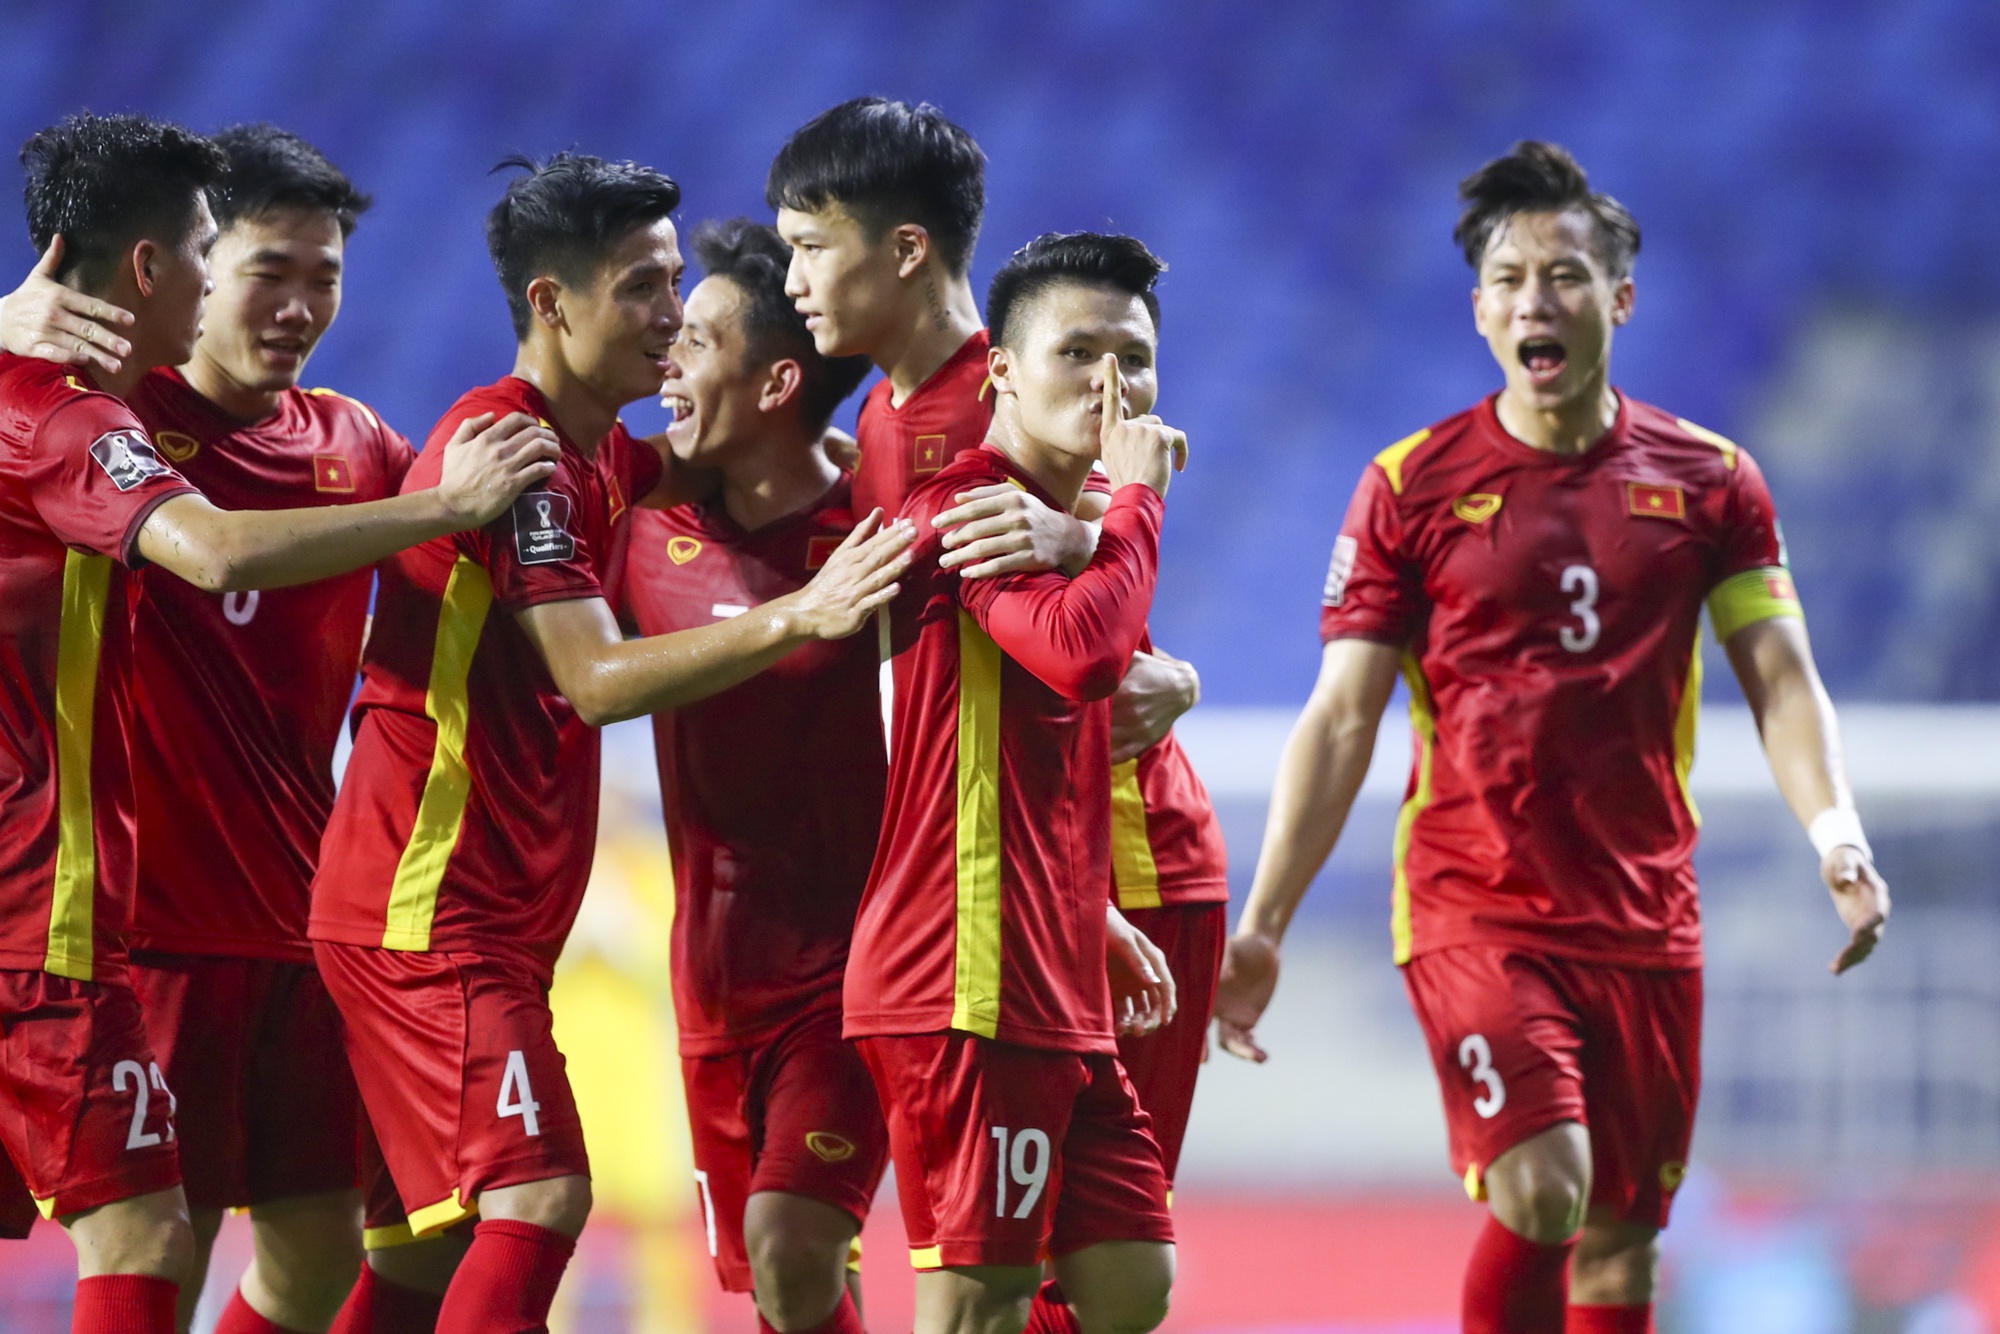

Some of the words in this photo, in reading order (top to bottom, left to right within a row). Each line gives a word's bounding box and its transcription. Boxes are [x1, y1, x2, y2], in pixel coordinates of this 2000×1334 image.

[529, 543, 563, 554] Qualifiers
[1560, 565, 1600, 651] 3
[496, 1050, 540, 1136] 4
[1459, 1034, 1506, 1120] 3
[991, 1127, 1050, 1219] 19
